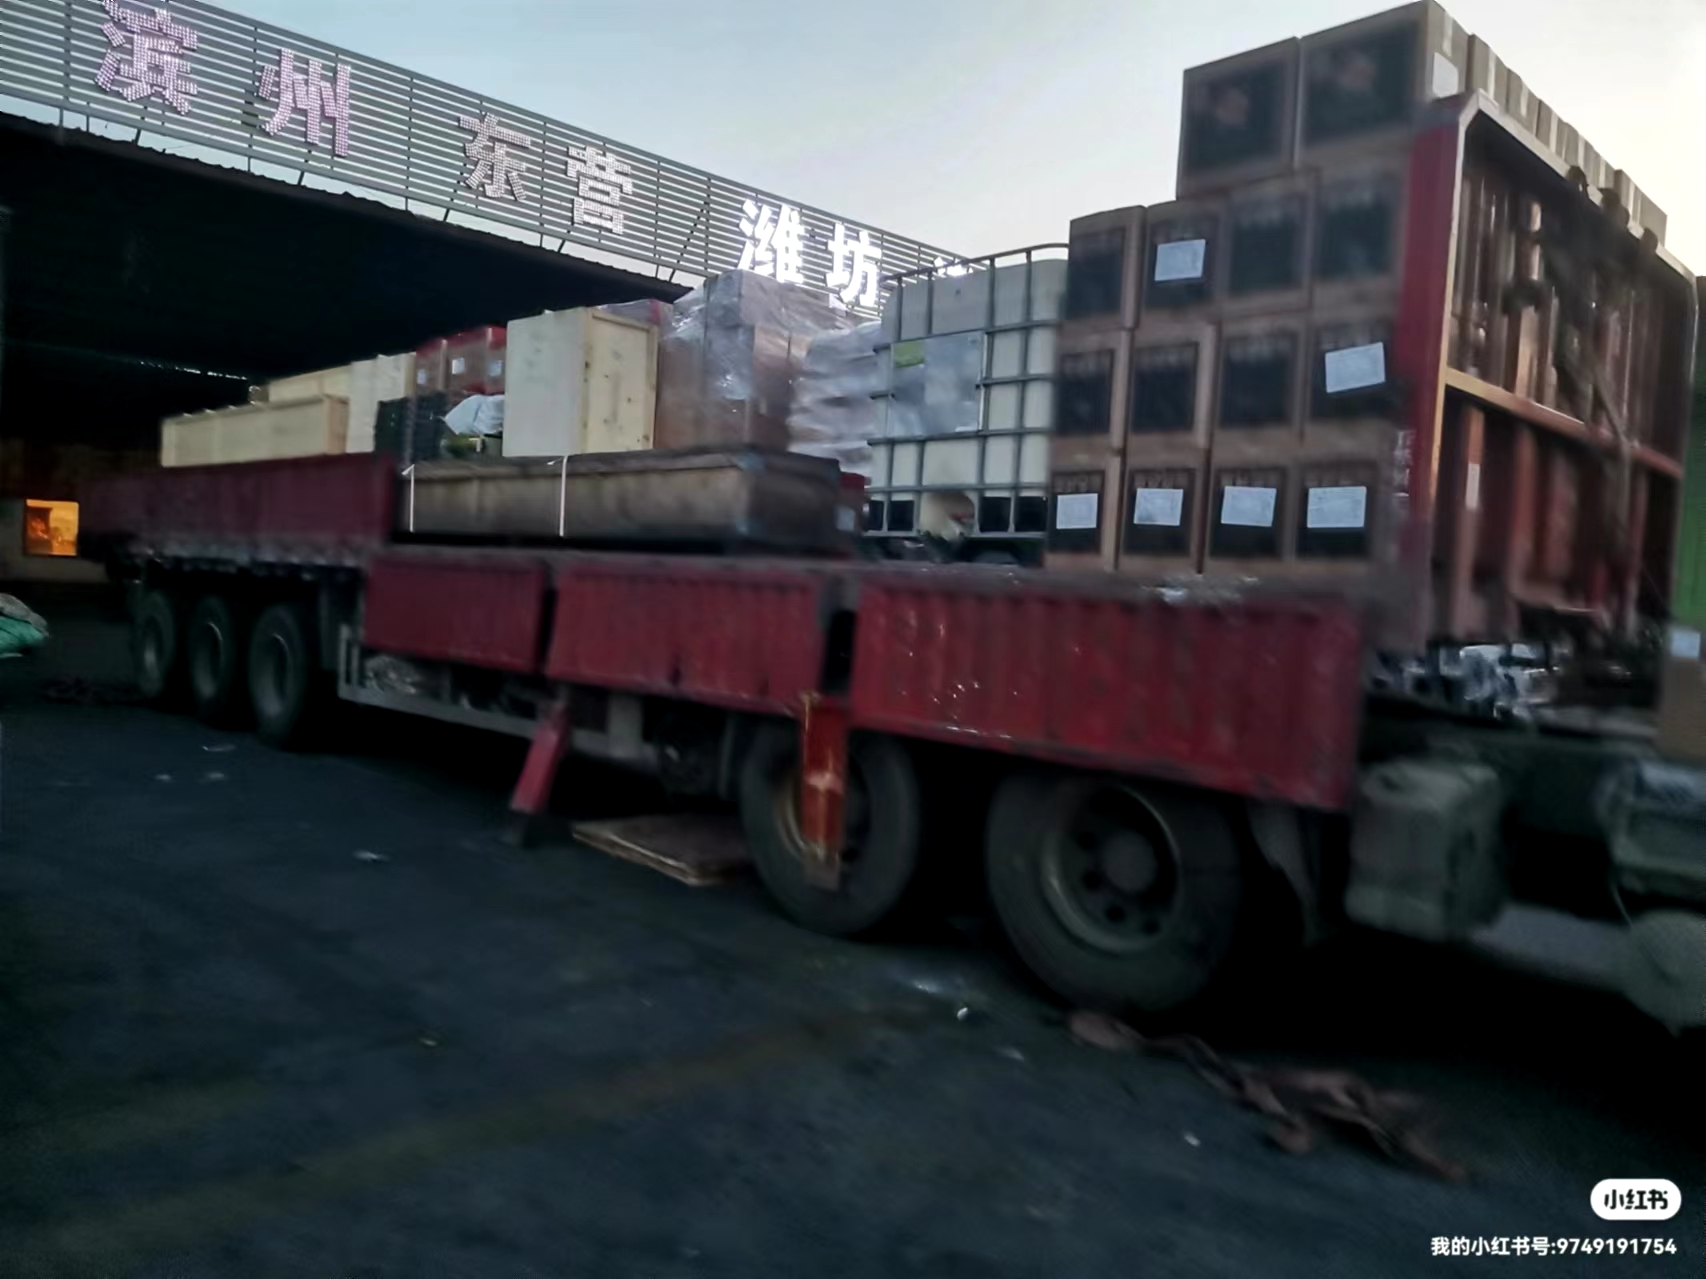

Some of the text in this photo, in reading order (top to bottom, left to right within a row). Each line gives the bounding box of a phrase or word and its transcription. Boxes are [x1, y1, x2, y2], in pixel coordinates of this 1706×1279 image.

[95, 0, 882, 307] 滨州 东营 潍坊
